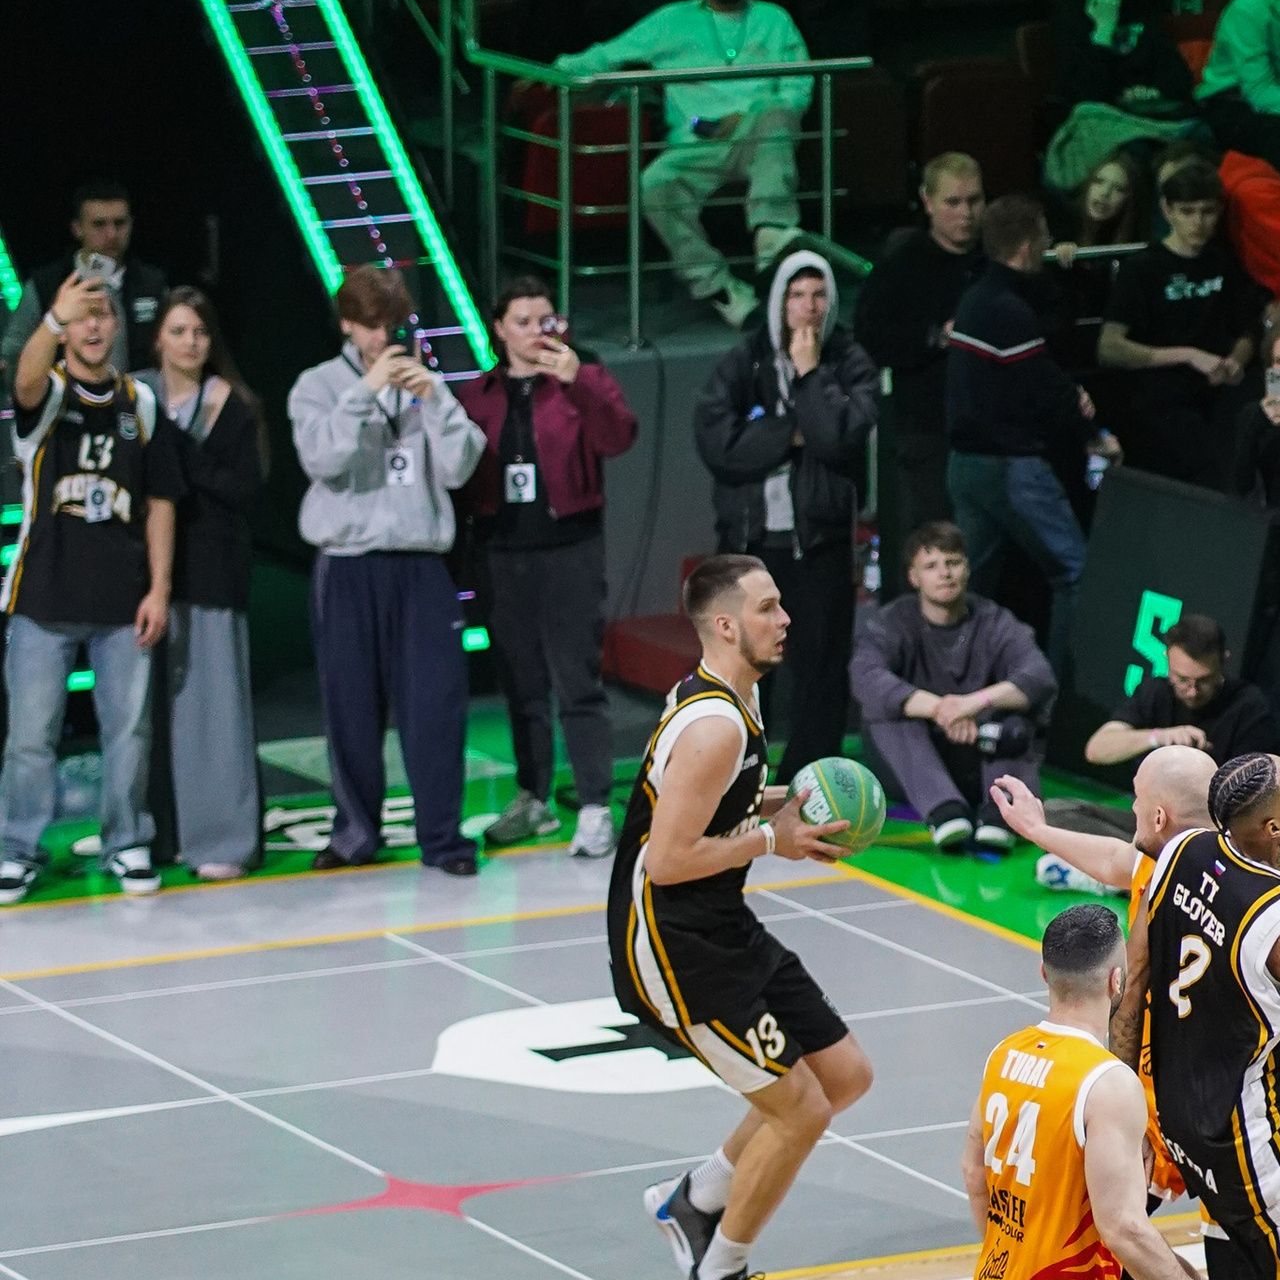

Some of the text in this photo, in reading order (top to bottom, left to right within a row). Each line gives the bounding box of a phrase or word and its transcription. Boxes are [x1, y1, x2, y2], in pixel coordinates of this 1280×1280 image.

[1173, 882, 1226, 948] GLOVER
[1199, 870, 1220, 904] TY
[1169, 934, 1212, 1019] 2
[746, 1012, 786, 1068] 13
[1000, 1048, 1054, 1089] TURAL
[984, 1092, 1041, 1187] 24
